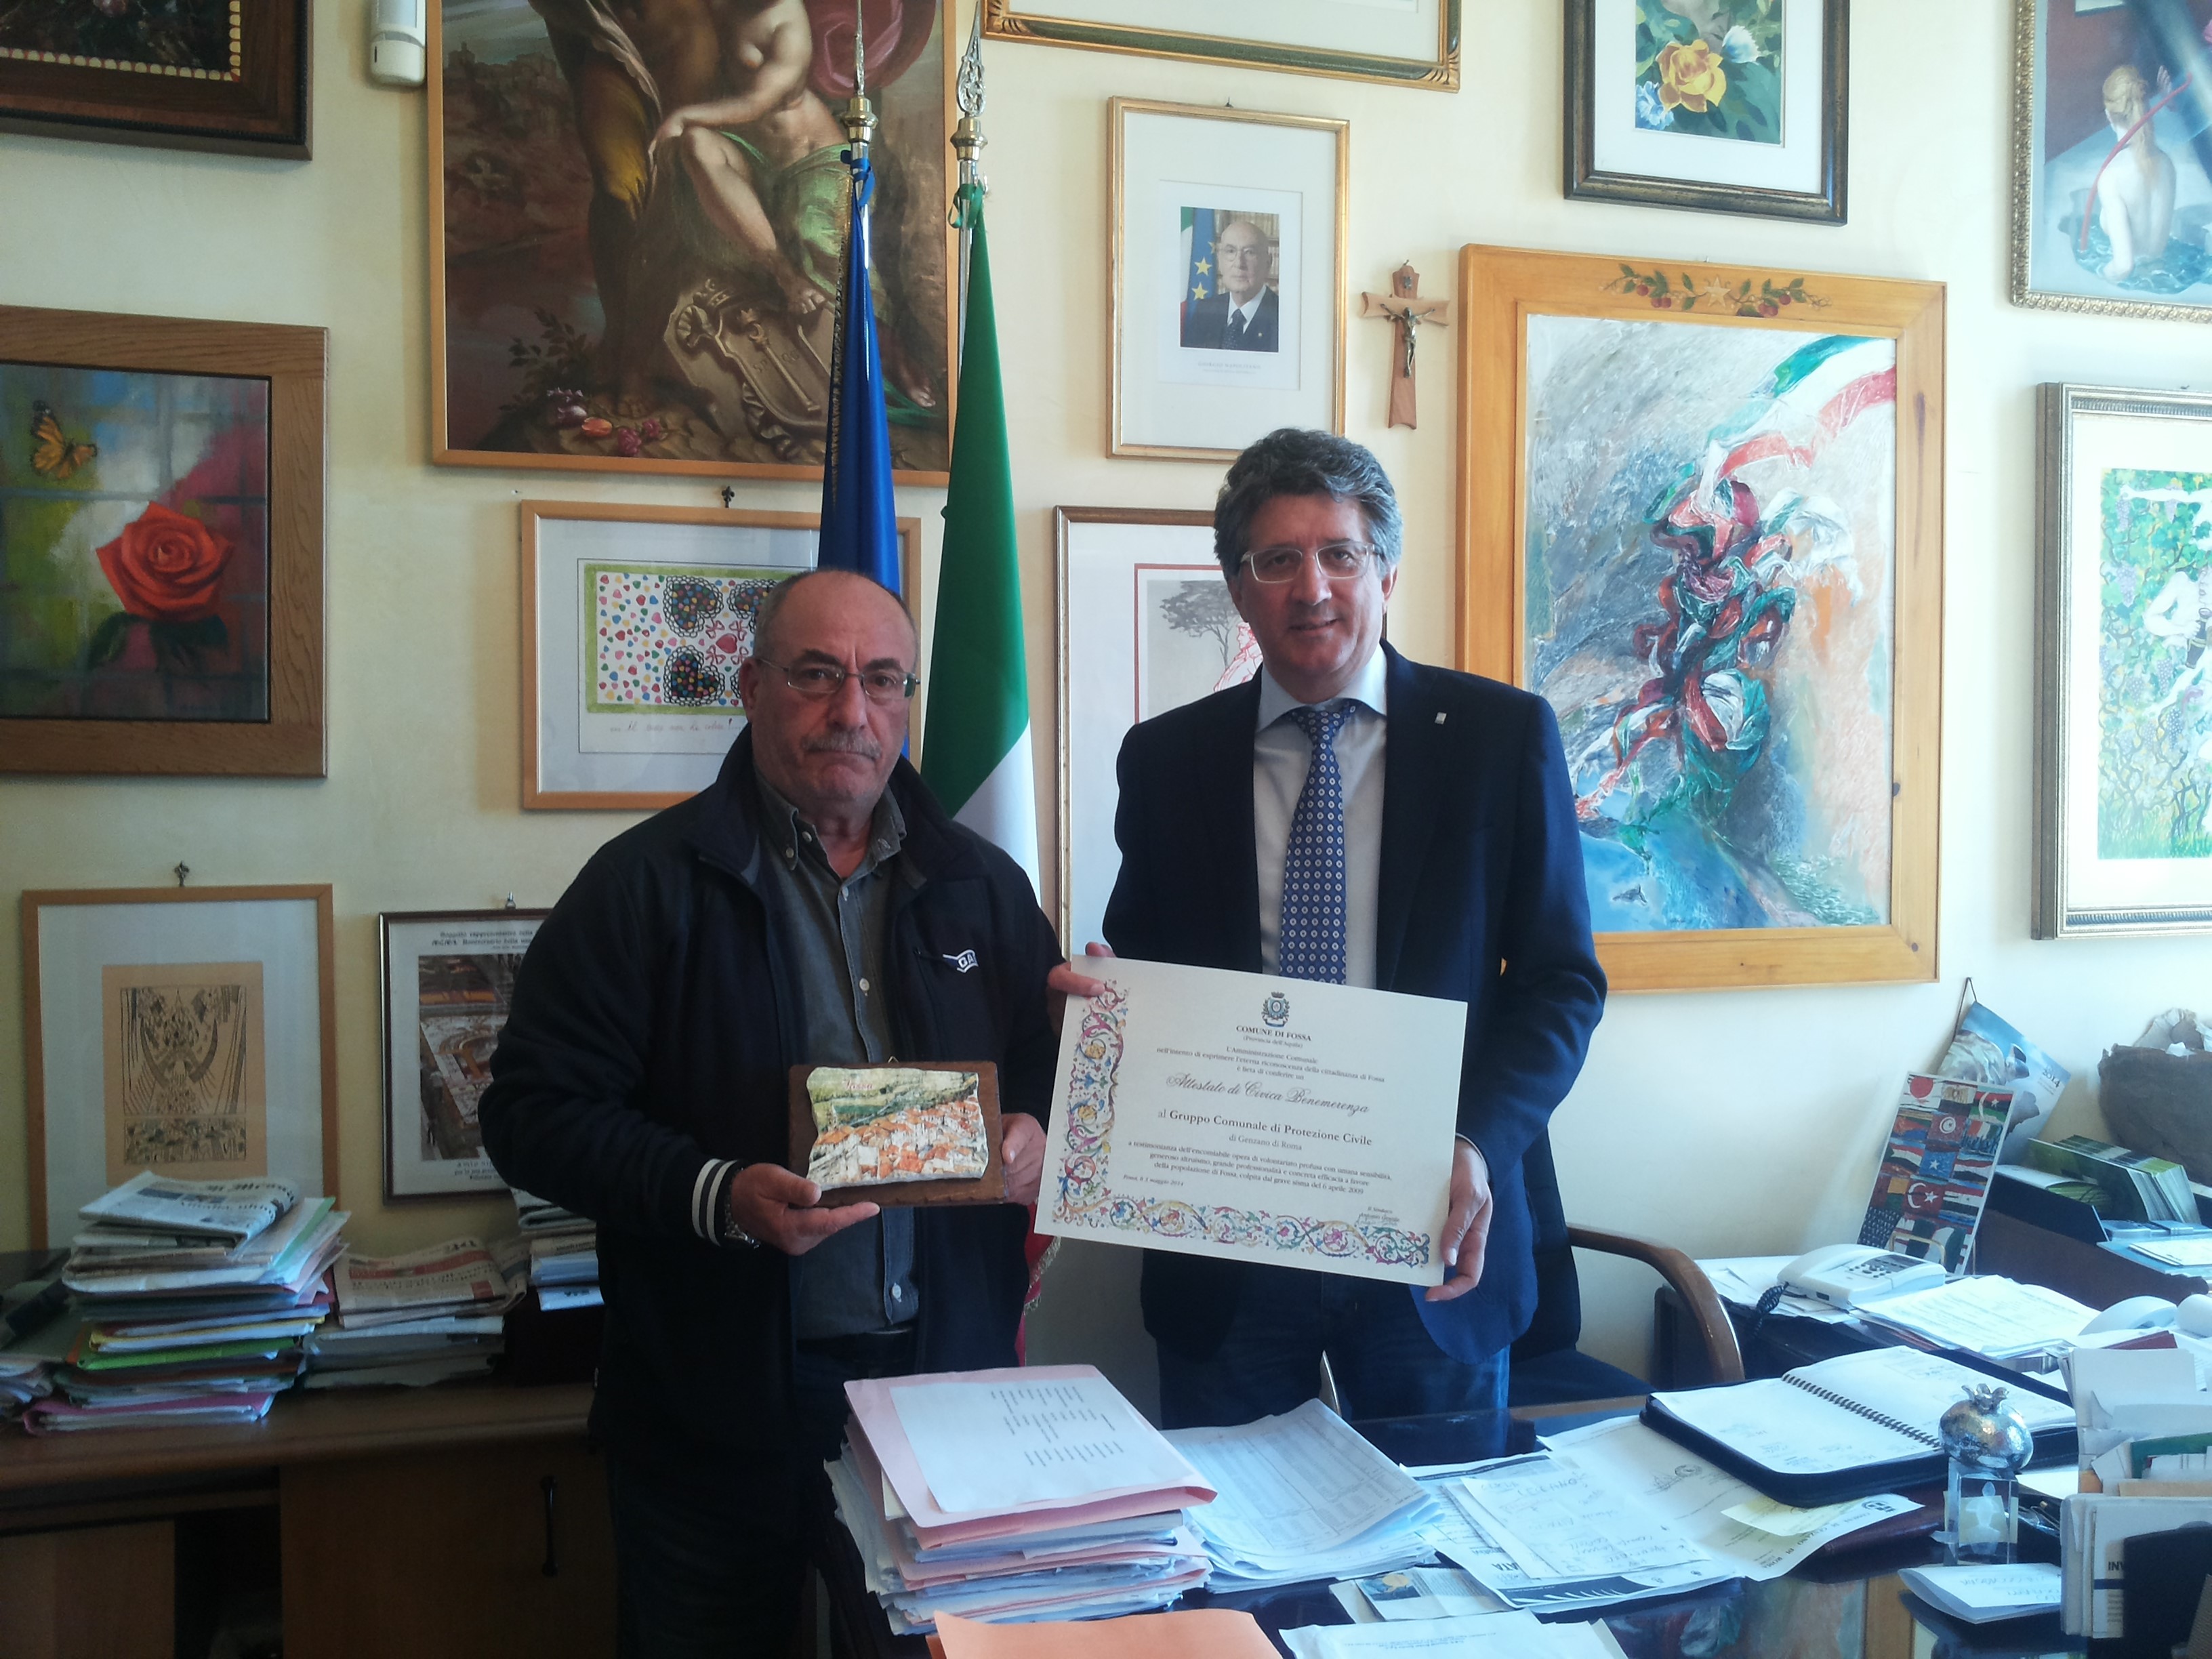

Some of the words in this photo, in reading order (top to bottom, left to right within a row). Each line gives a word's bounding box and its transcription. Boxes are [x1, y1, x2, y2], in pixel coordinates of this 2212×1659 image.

[1236, 1026, 1270, 1036] COMUNE
[1286, 1032, 1311, 1041] FOSSA
[1227, 1046, 1284, 1059] L'Amministrazione
[1286, 1055, 1317, 1064] Comunale
[1261, 1061, 1303, 1071] riconoscenza
[1321, 1069, 1358, 1079] cittadinanza
[2043, 1068, 2060, 1088] 2014
[1166, 1073, 1225, 1092] Attestato
[1227, 1084, 1240, 1094] di
[1245, 1082, 1282, 1101] Civica
[1285, 1089, 1369, 1117] Benemerenza
[1158, 1109, 1166, 1118] al
[1170, 1111, 1210, 1125] Gruppo
[1214, 1115, 1267, 1130] Comunale
[1271, 1124, 1280, 1132] di
[1284, 1125, 1339, 1141] Protezione
[1343, 1134, 1372, 1145] Civile
[1238, 1135, 1270, 1146] Genzano
[1282, 1141, 1302, 1151] Roma
[1133, 1141, 1177, 1151] testimonianza
[1260, 1158, 1298, 1167] volontariato
[1170, 1165, 1210, 1174] popolazione
[1240, 1172, 1261, 1181] colpita
[1317, 1174, 1343, 1183] efficacia
[1350, 1178, 1369, 1186] favore
